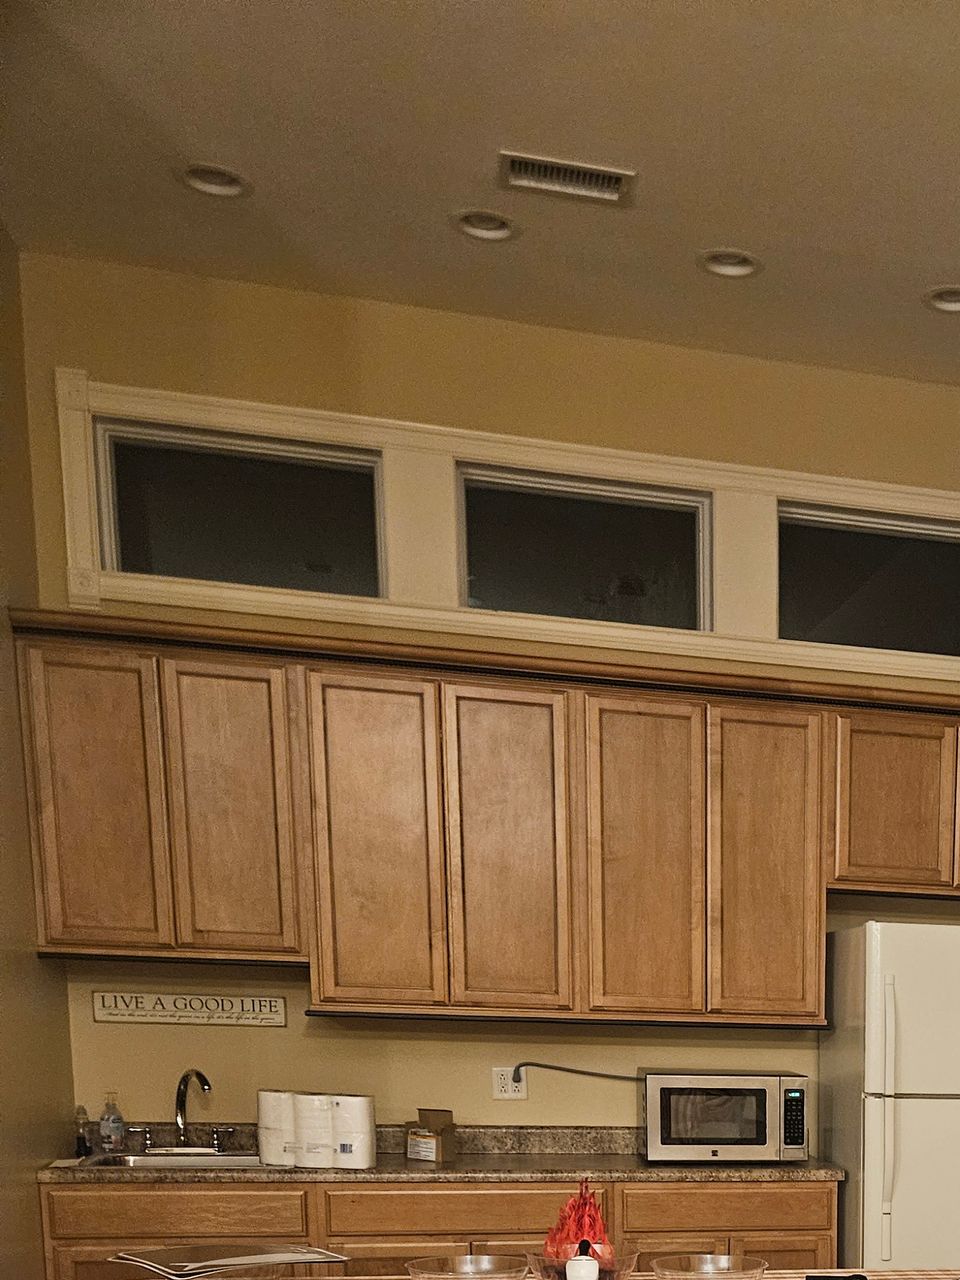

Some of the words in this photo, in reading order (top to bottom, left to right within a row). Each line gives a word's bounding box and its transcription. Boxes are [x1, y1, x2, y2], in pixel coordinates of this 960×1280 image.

[101, 995, 145, 1009] LIVE
[153, 996, 166, 1010] A
[173, 997, 234, 1012] GOOD
[240, 998, 279, 1013] LIFE
